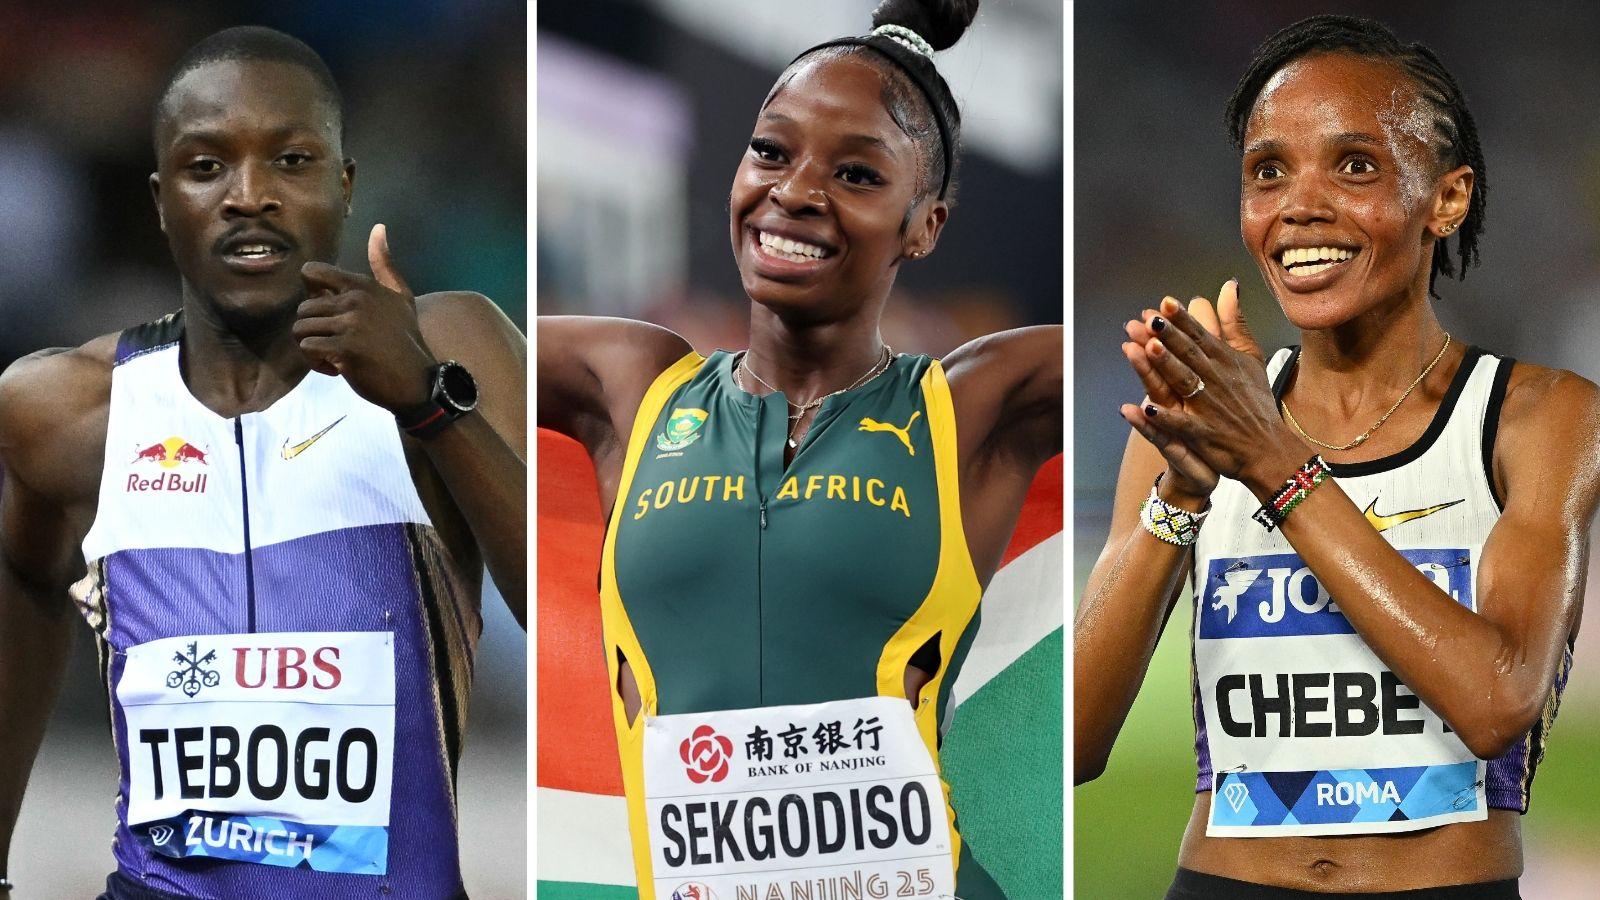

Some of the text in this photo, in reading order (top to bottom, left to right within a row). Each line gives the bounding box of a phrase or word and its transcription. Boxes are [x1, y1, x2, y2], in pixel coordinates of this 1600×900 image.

[127, 472, 207, 493] Red Bull
[634, 474, 910, 520] SOUTH AFRICA
[232, 646, 342, 690] UBS
[1215, 672, 1455, 738] CHEBE
[744, 716, 884, 762] 南京银行
[139, 724, 378, 803] TEBOGO
[748, 755, 886, 778] BANK OF NANJING
[1316, 780, 1402, 806] ROMA
[185, 815, 313, 859] ZURICH
[660, 780, 932, 868] SEKGODISO
[896, 868, 935, 897] 25
